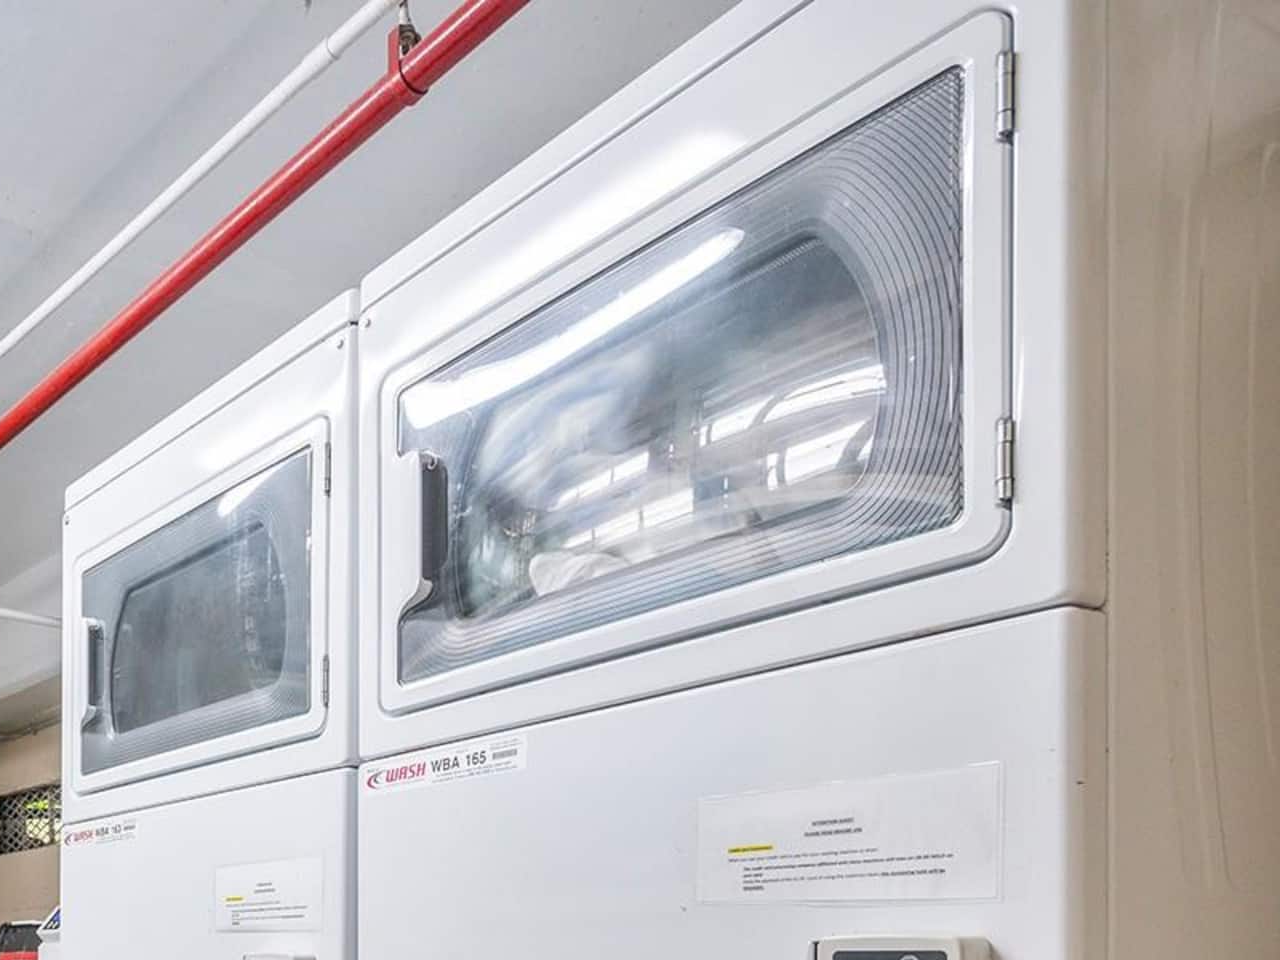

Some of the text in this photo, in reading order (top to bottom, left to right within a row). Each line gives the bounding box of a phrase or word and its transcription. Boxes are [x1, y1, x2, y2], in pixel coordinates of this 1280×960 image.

[385, 761, 426, 782] WASH
[431, 755, 460, 773] WBA
[466, 750, 487, 766] 165
